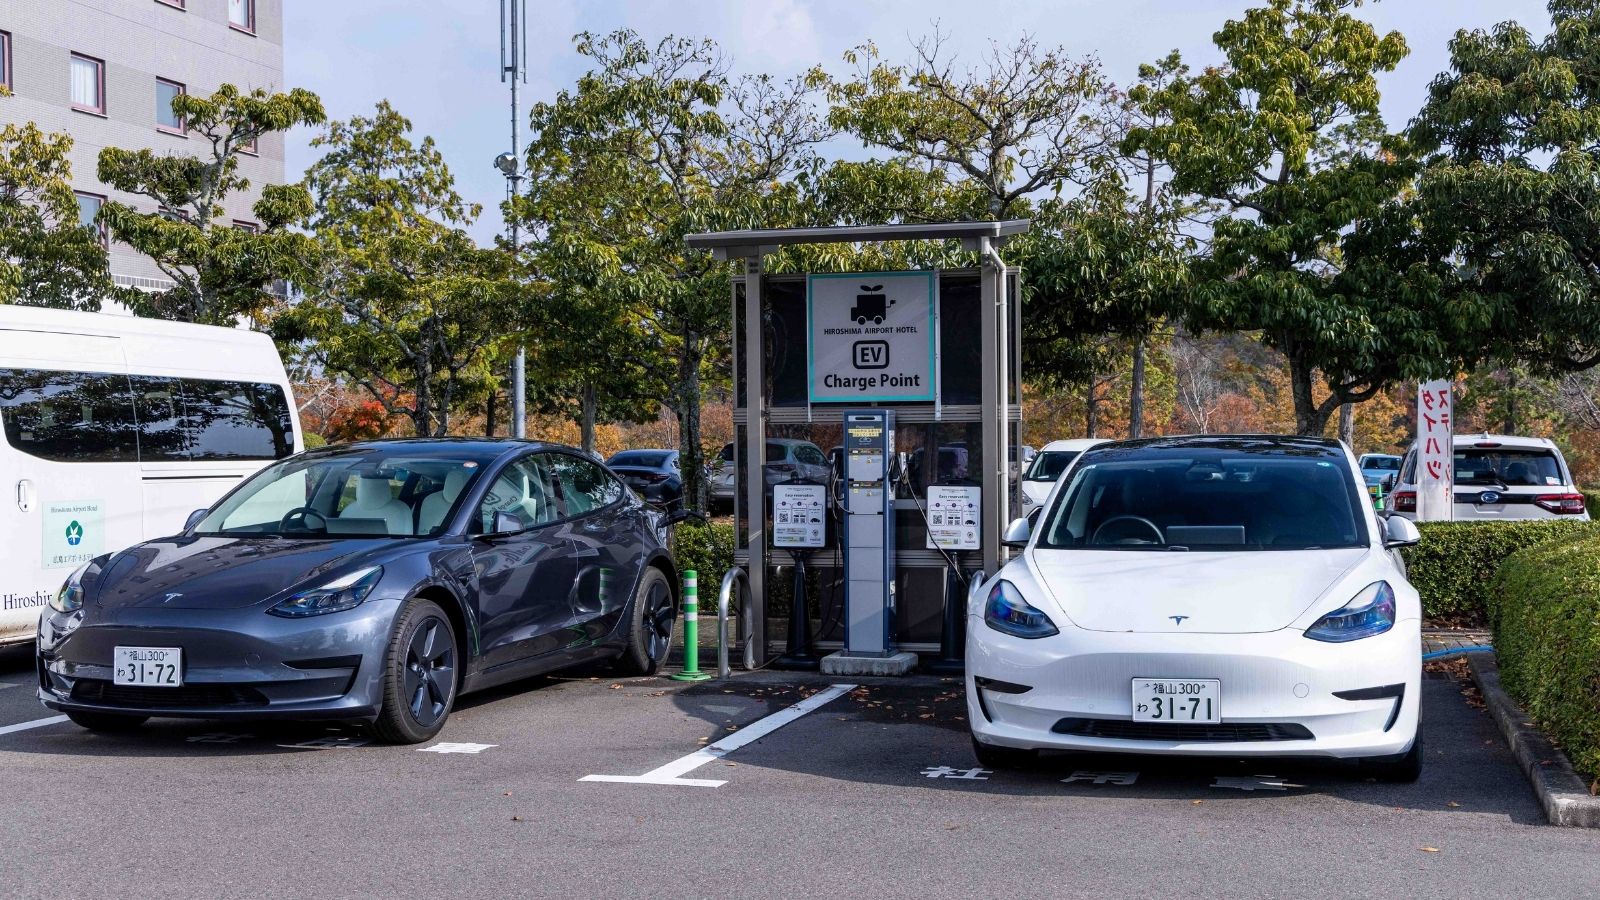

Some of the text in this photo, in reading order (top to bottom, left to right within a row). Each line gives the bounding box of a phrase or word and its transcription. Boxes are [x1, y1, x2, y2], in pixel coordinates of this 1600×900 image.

[860, 347, 882, 363] EV
[824, 373, 920, 391] Charge Point
[117, 663, 176, 684] わ 31-72
[1137, 697, 1212, 720] わ 31-71
